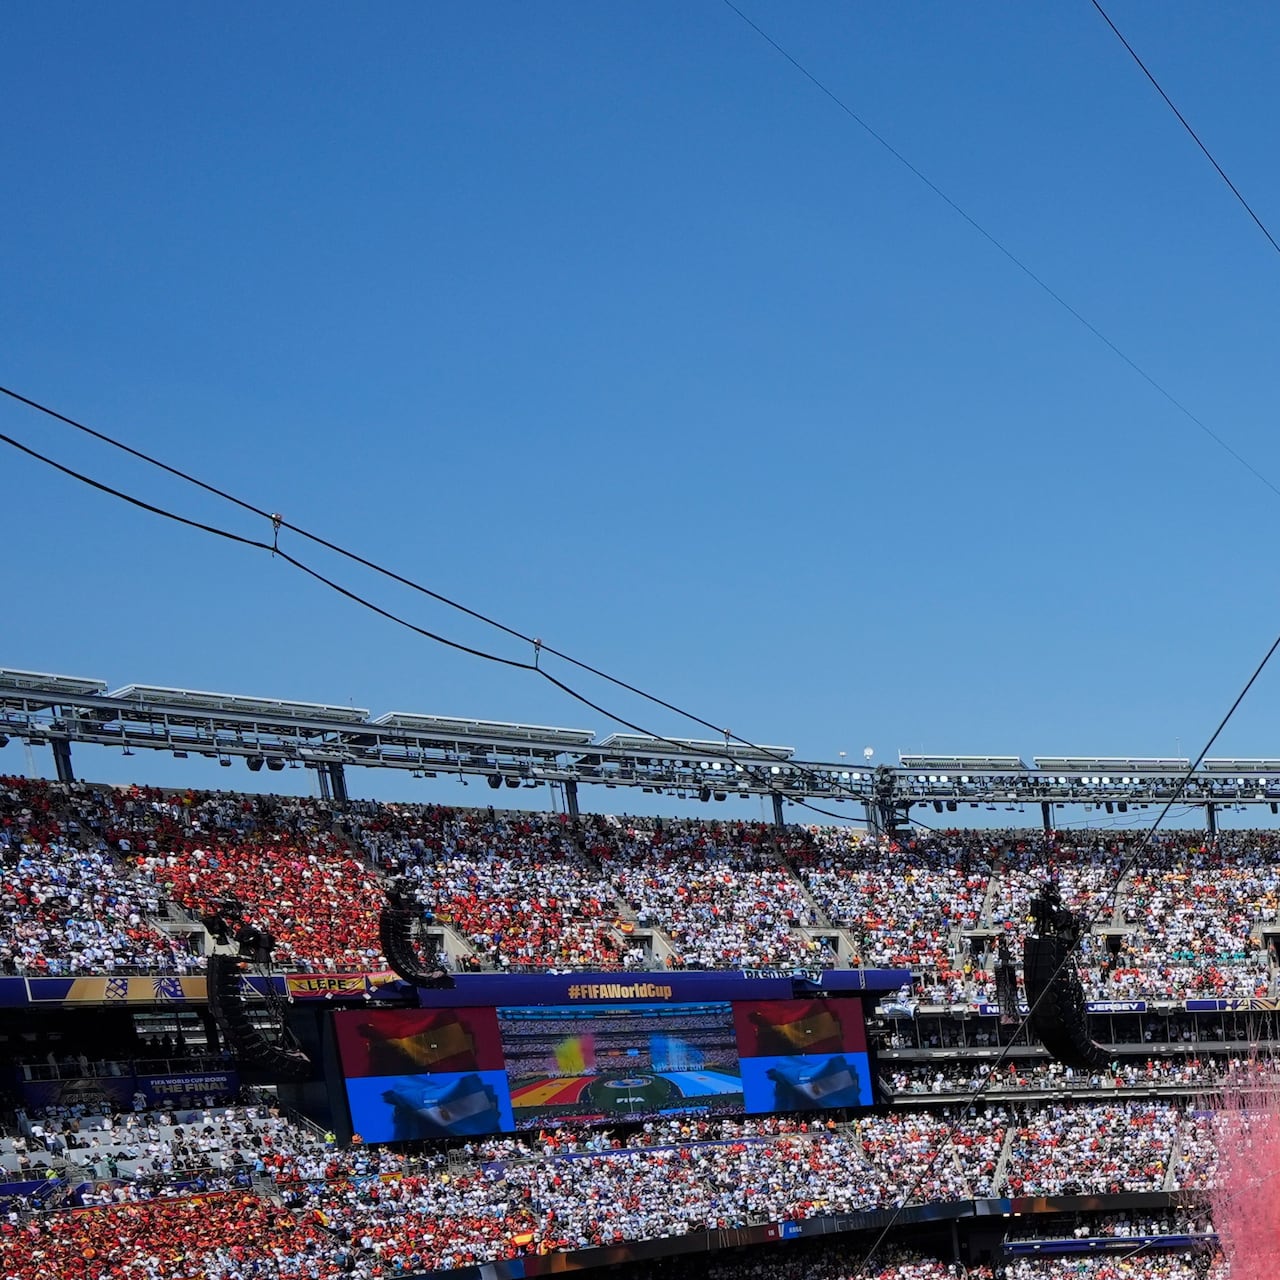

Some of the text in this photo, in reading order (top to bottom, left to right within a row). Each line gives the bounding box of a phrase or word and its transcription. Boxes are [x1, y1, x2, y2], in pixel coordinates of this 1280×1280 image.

[308, 979, 347, 991] LEPE
[568, 983, 672, 1000] #FIFAWorldCup
[1088, 1002, 1138, 1012] JERSEY
[153, 1081, 229, 1094] THE FINAL
